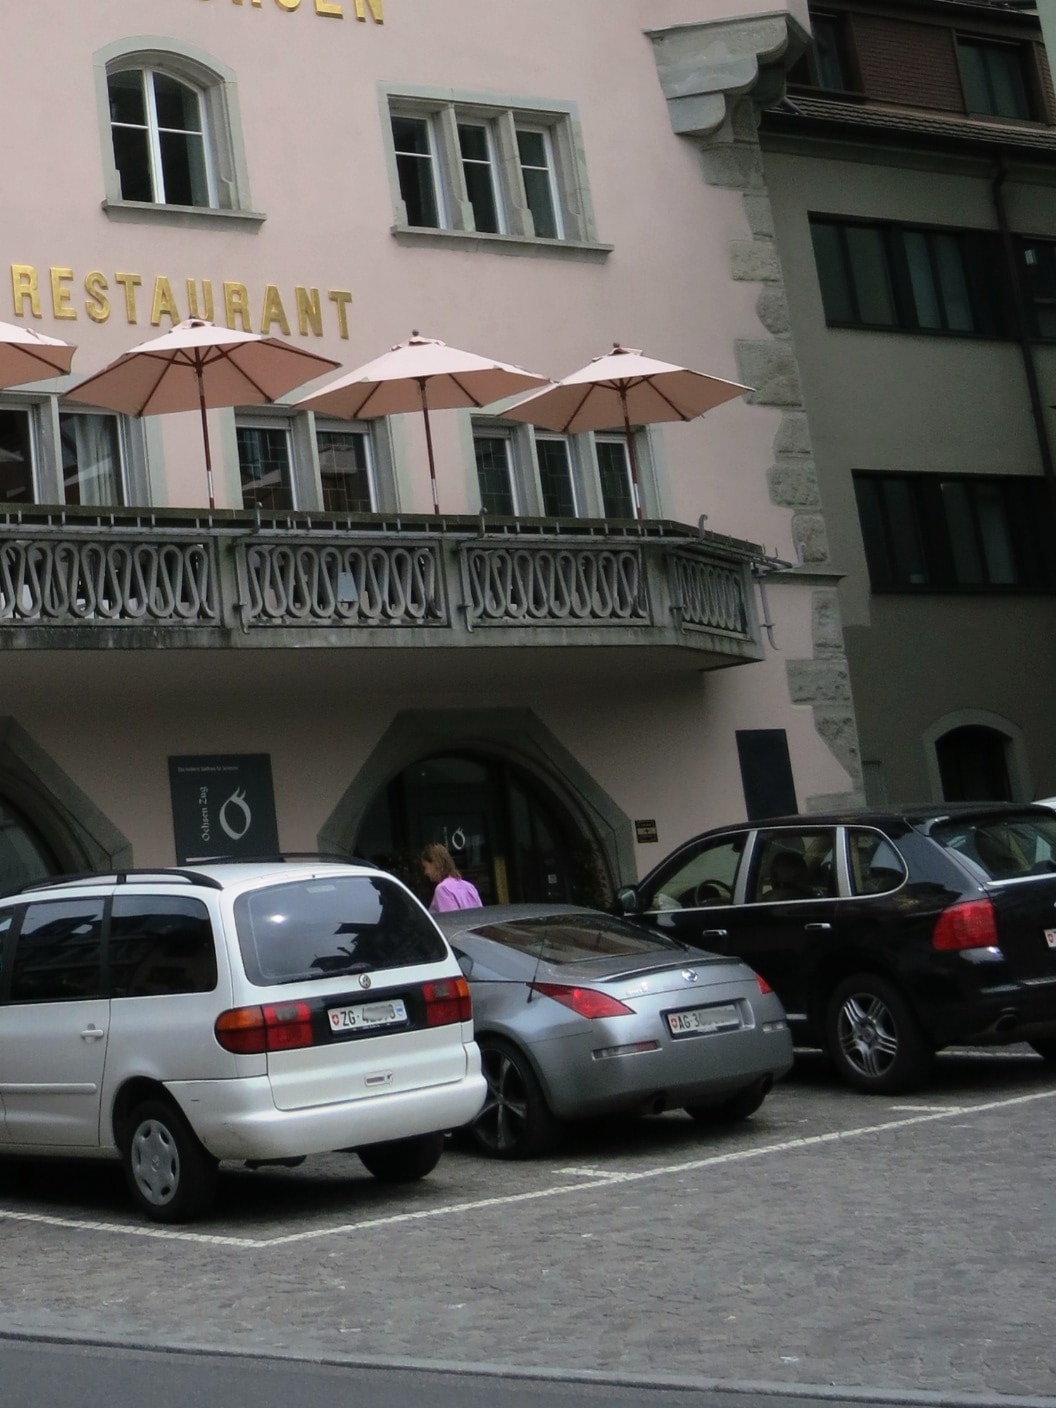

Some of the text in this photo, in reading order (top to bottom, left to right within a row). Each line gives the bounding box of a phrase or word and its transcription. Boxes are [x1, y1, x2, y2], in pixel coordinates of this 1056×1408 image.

[11, 264, 353, 340] RESTAURANT
[198, 786, 210, 842] Ochsen Zug
